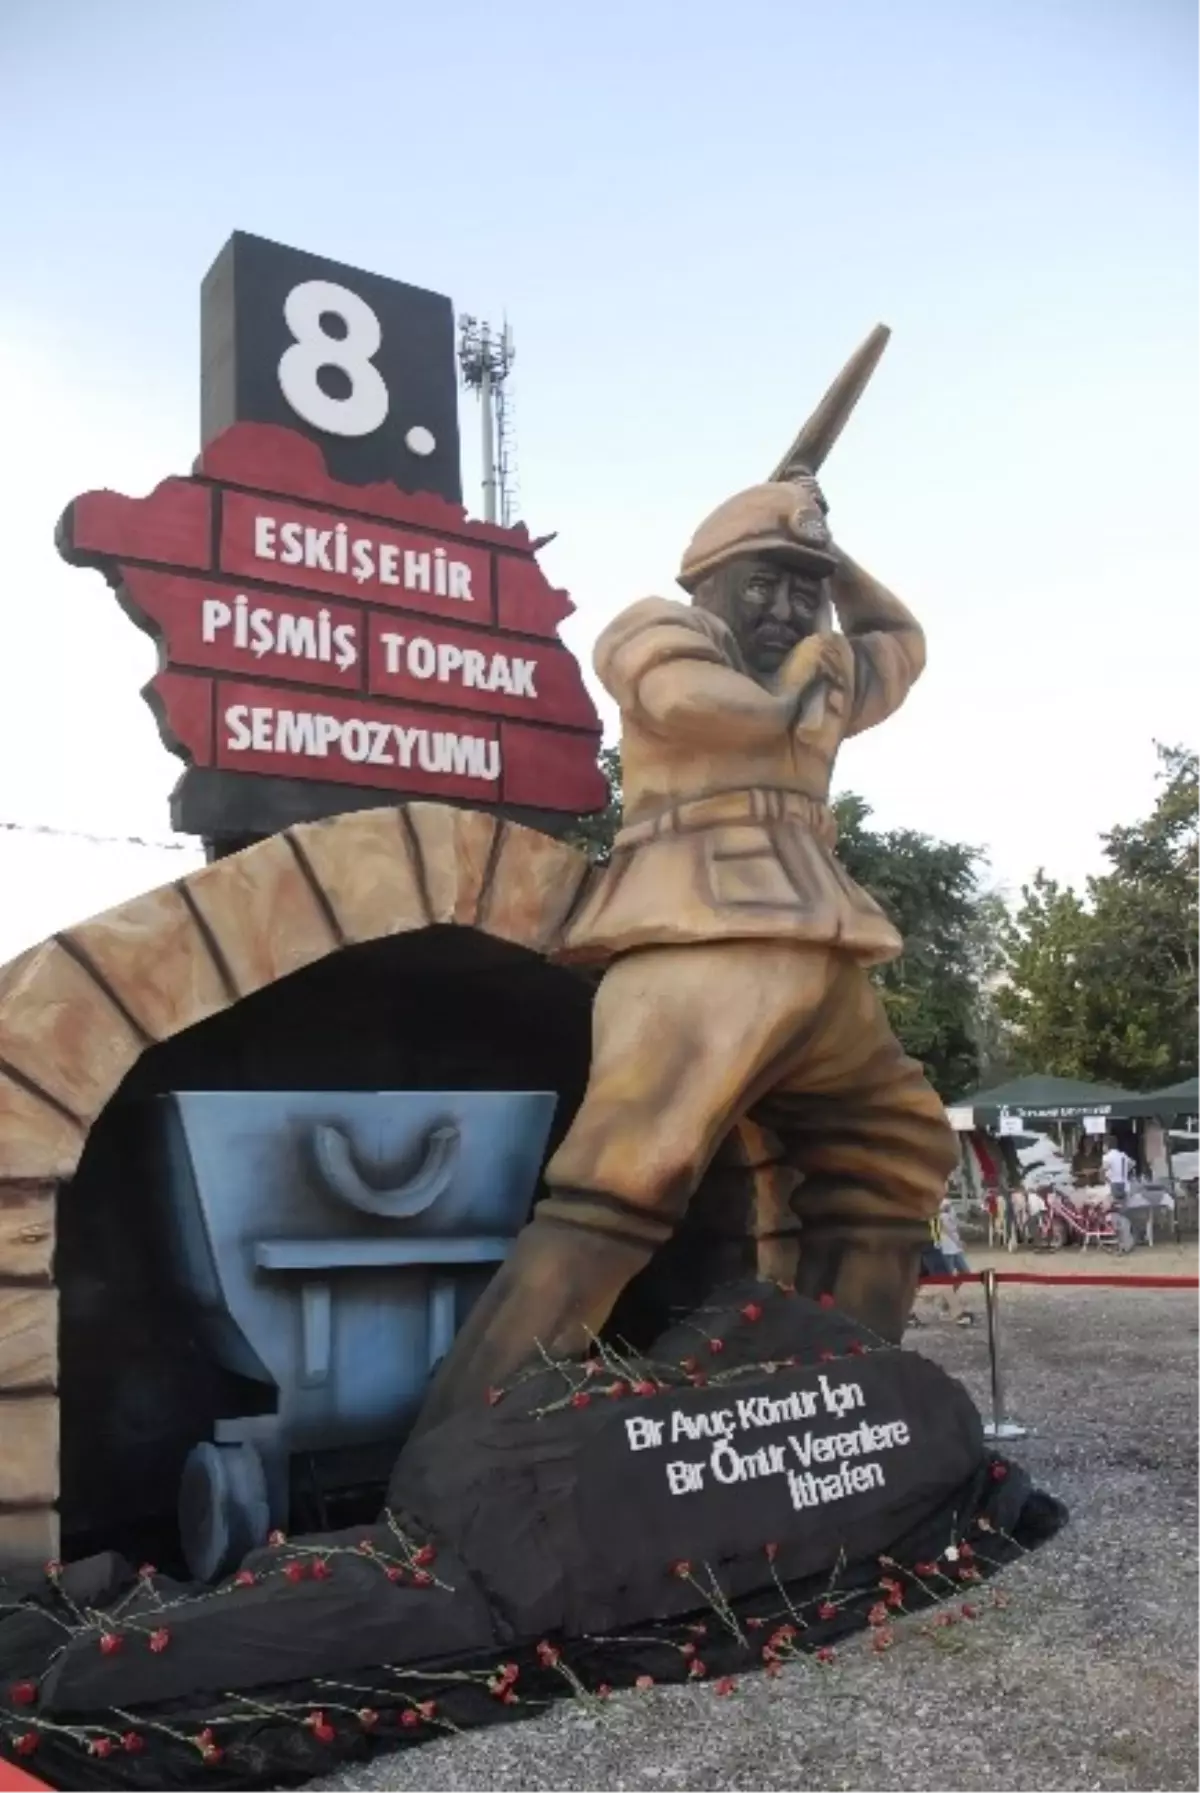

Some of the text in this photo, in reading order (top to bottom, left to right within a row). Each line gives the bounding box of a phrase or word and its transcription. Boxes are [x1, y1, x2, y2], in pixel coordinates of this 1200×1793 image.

[277, 279, 437, 456] 8.
[254, 515, 475, 602] ESKİŞEHİR
[201, 593, 539, 699] PİŞMİŞ TOPRAK
[223, 704, 502, 781] SEMPOZYUMU
[624, 1416, 665, 1451] Bir
[671, 1409, 737, 1443] Avuç
[666, 1460, 706, 1495] Bir
[788, 1420, 911, 1467] Verenlere
